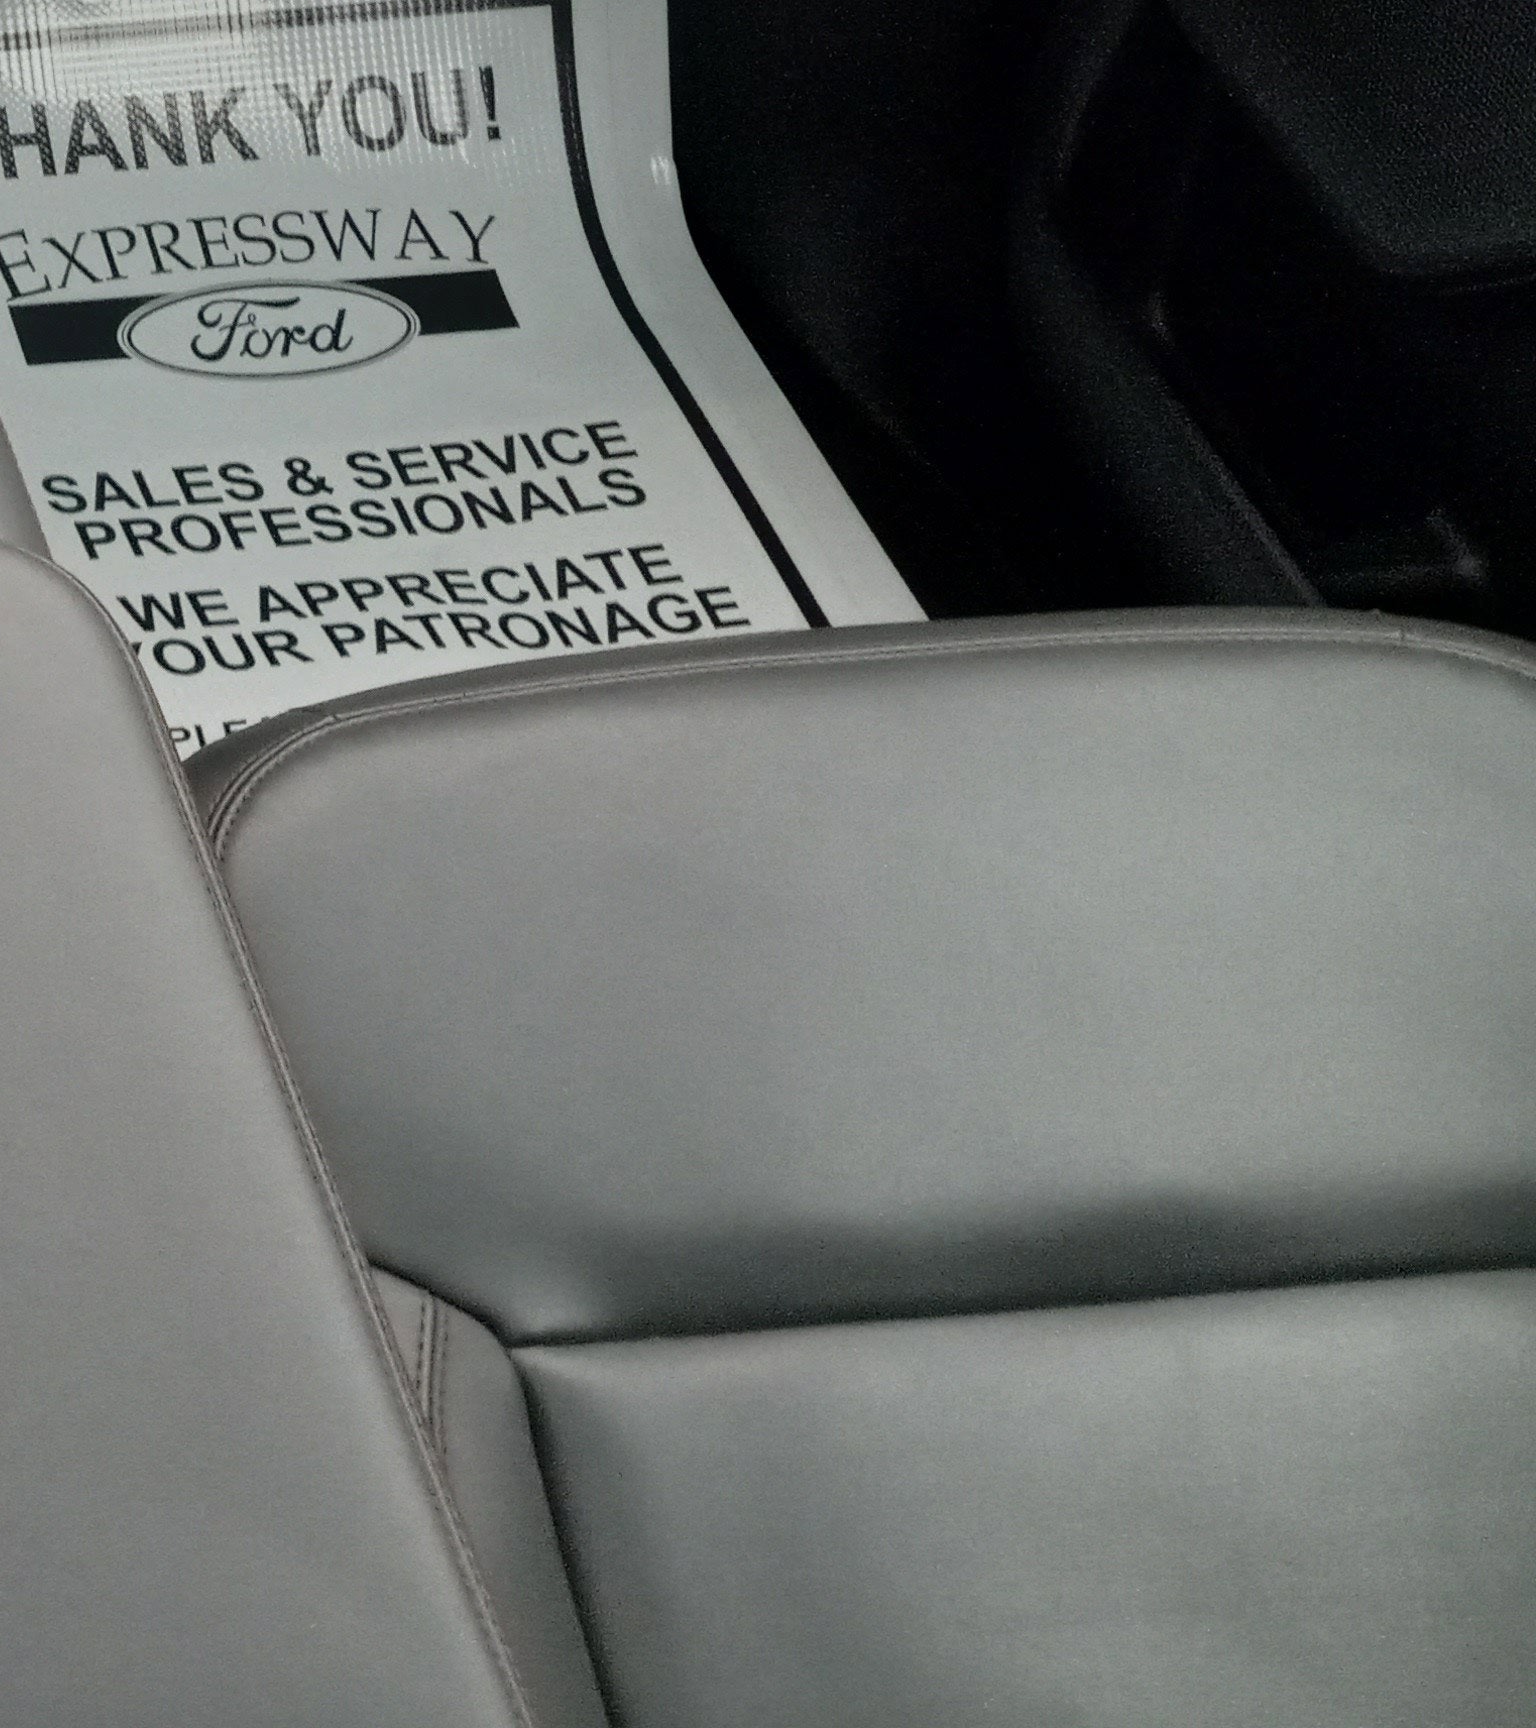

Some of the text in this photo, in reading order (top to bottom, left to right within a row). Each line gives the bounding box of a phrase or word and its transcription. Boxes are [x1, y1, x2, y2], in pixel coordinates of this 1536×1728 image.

[273, 67, 503, 157] YOU!
[190, 297, 354, 360] Ford
[41, 419, 639, 515] SALES & SERVICE
[74, 468, 647, 560] PROFESSIONALS
[118, 543, 683, 633] WE APPRECIATE
[130, 586, 753, 676] OUR PATRONAGE
